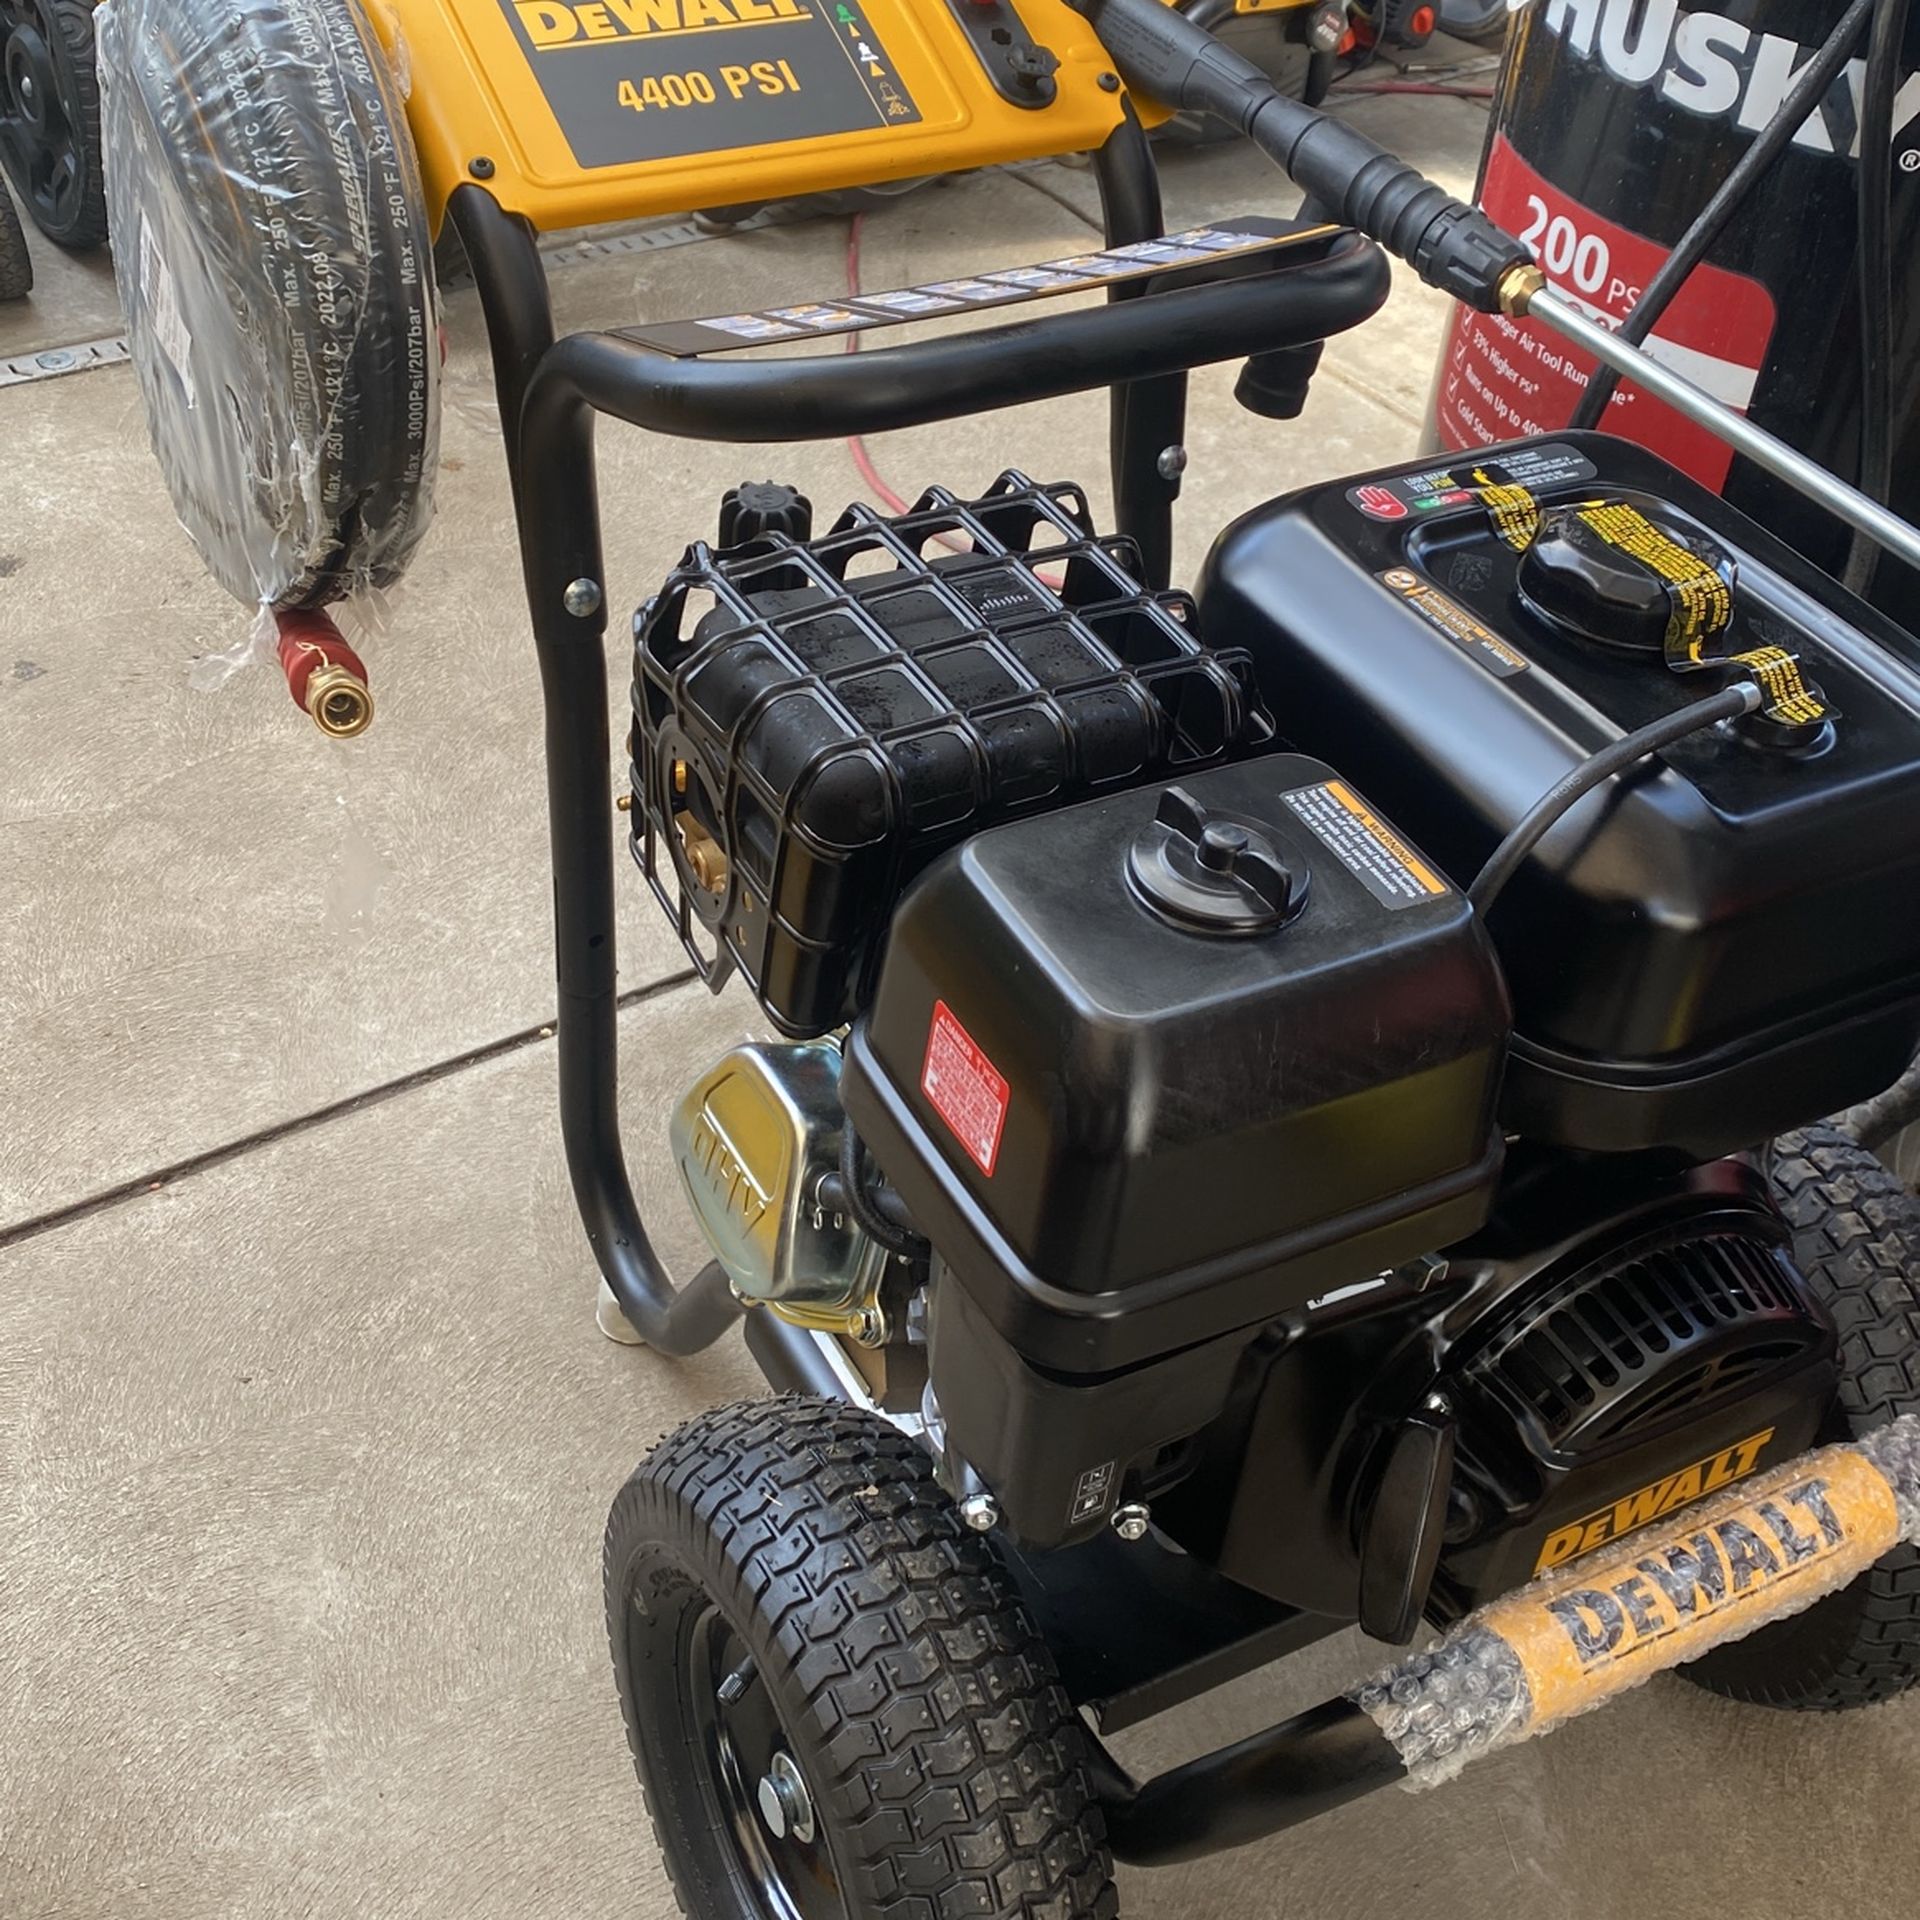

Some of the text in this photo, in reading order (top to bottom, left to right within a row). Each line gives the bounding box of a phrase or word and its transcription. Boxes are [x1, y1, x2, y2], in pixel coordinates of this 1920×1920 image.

[617, 60, 801, 112] 4400 PSI
[400, 240, 417, 285] Max.
[1519, 194, 1610, 294] 200
[283, 263, 301, 308] Max.
[407, 306, 425, 440] 3000Psi/207bar
[1473, 327, 1489, 357] 33%
[1489, 347, 1520, 384] Higher
[1519, 331, 1536, 353] Air
[1536, 342, 1564, 373] Tool
[1456, 398, 1475, 426] Cold
[1482, 387, 1494, 405] on
[1494, 394, 1508, 418] Up
[1509, 408, 1521, 427] to
[323, 470, 342, 503] Max.
[403, 448, 422, 484] Max.
[1369, 821, 1416, 866] WARNING
[1535, 1432, 1774, 1572] DEWALT
[1547, 1480, 1847, 1664] DEWALT
